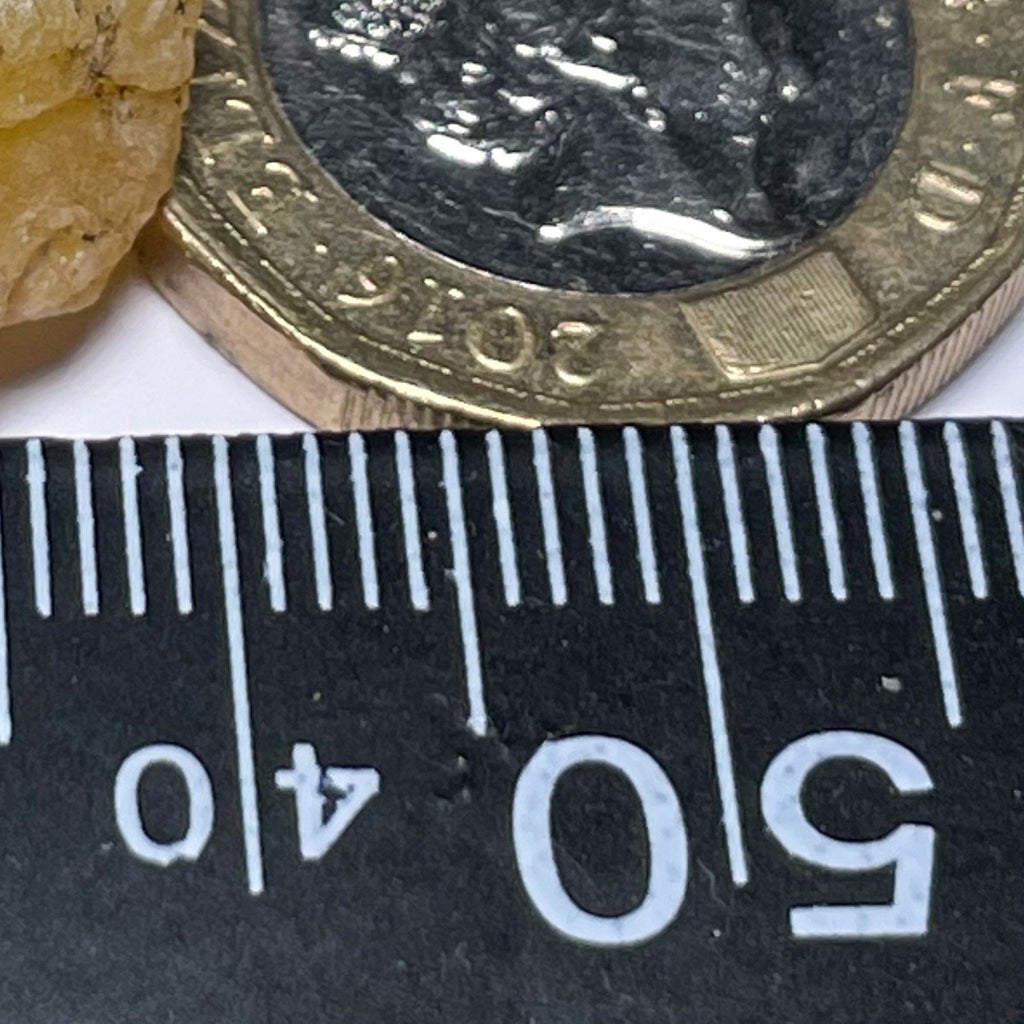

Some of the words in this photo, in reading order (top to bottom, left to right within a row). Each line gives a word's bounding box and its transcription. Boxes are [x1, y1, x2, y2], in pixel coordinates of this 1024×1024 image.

[334, 254, 602, 388] 2016
[114, 741, 378, 865] 40
[512, 729, 936, 947] 50
